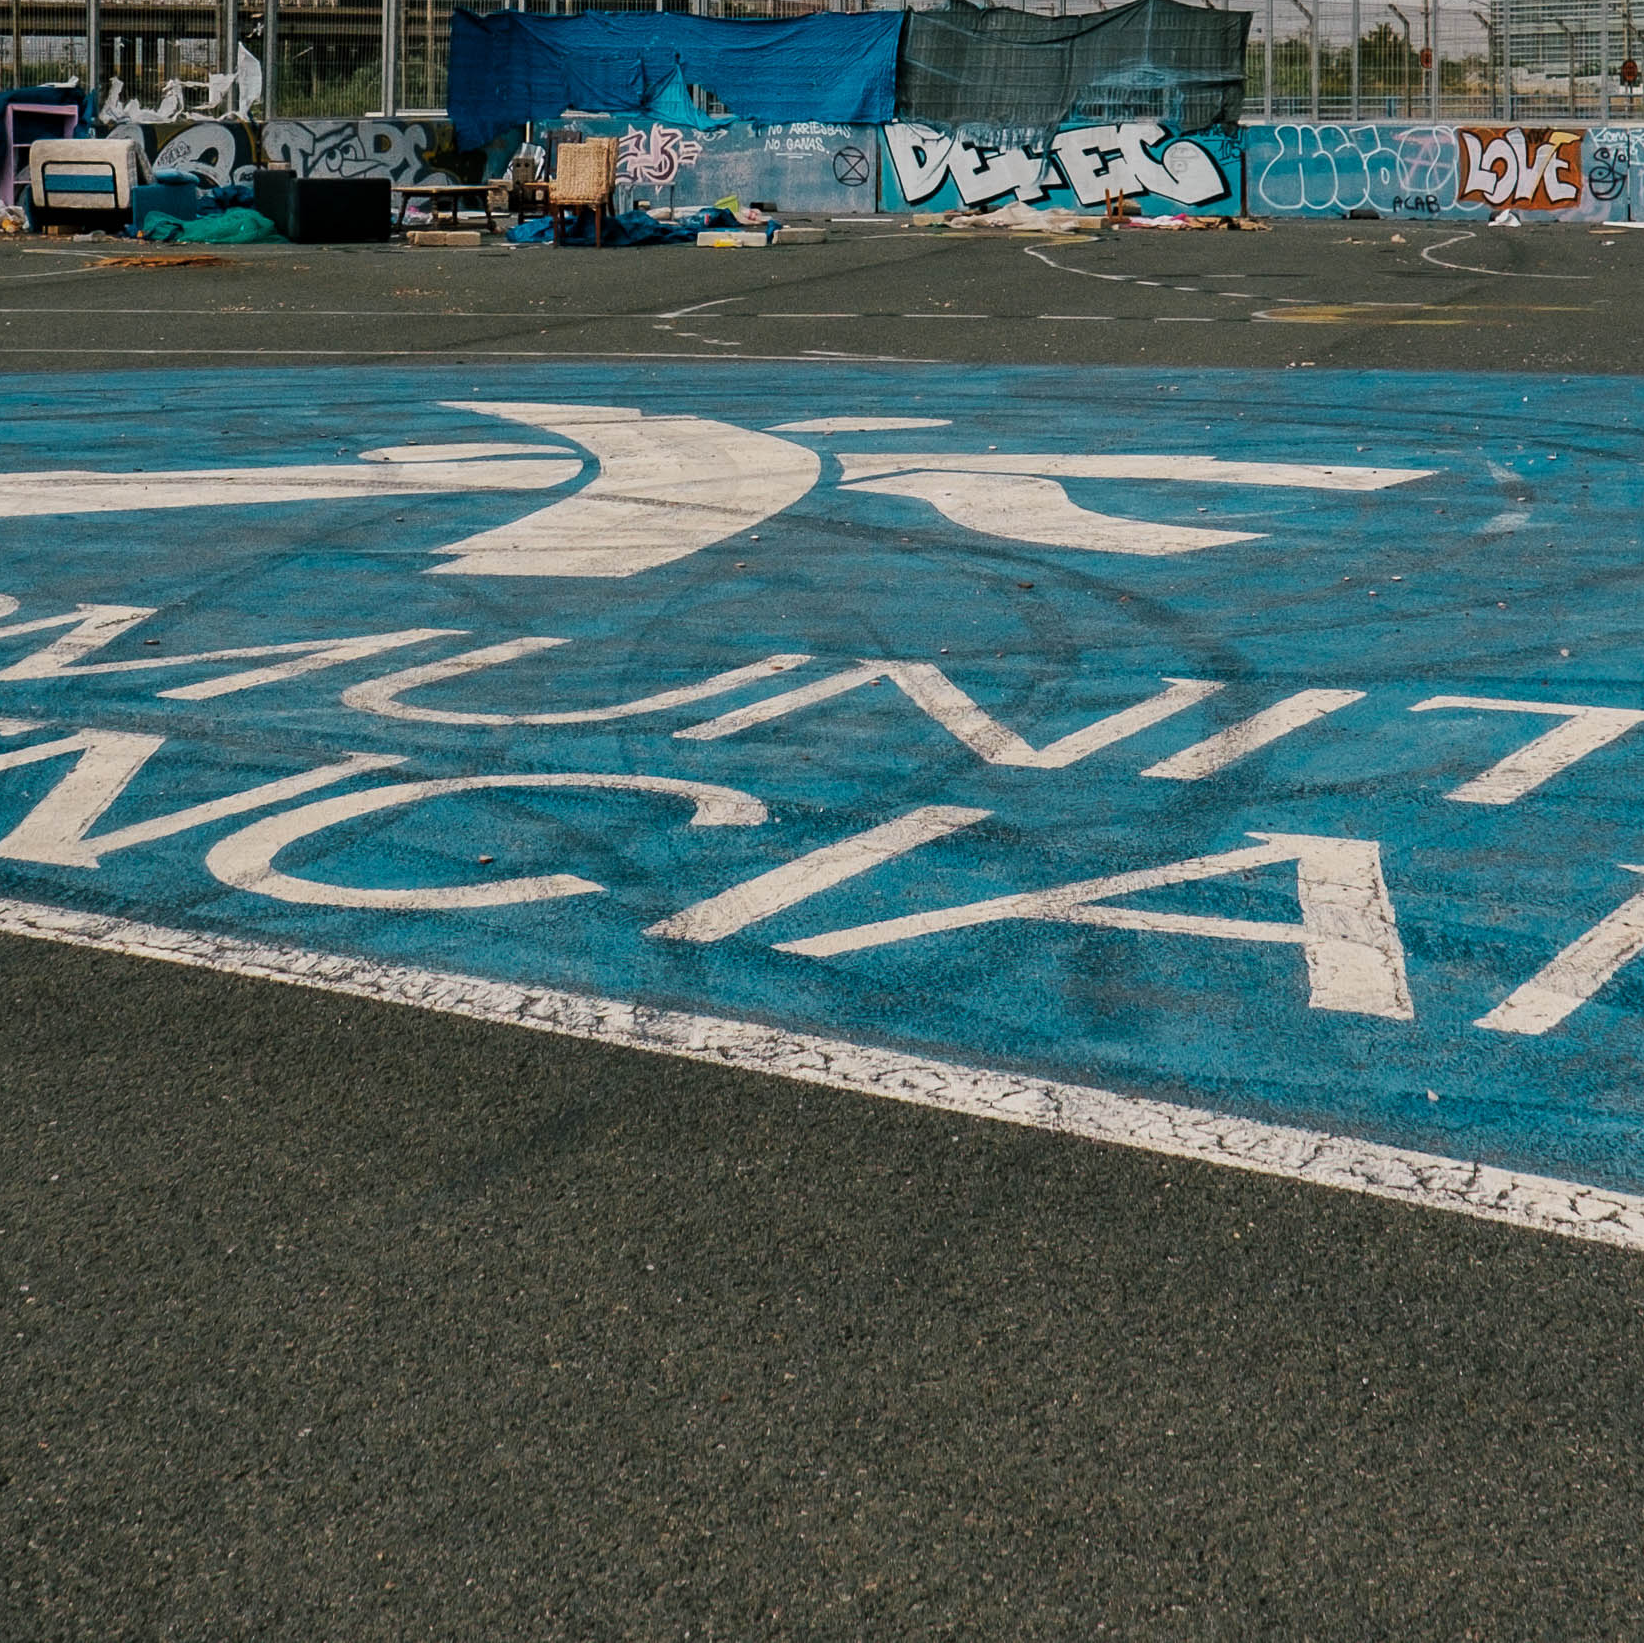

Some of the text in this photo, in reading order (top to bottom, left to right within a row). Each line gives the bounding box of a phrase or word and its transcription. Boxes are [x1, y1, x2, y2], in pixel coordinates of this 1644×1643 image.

[763, 138, 781, 152] NO
[1462, 127, 1582, 205] LOVE
[1392, 194, 1441, 213] ACAB
